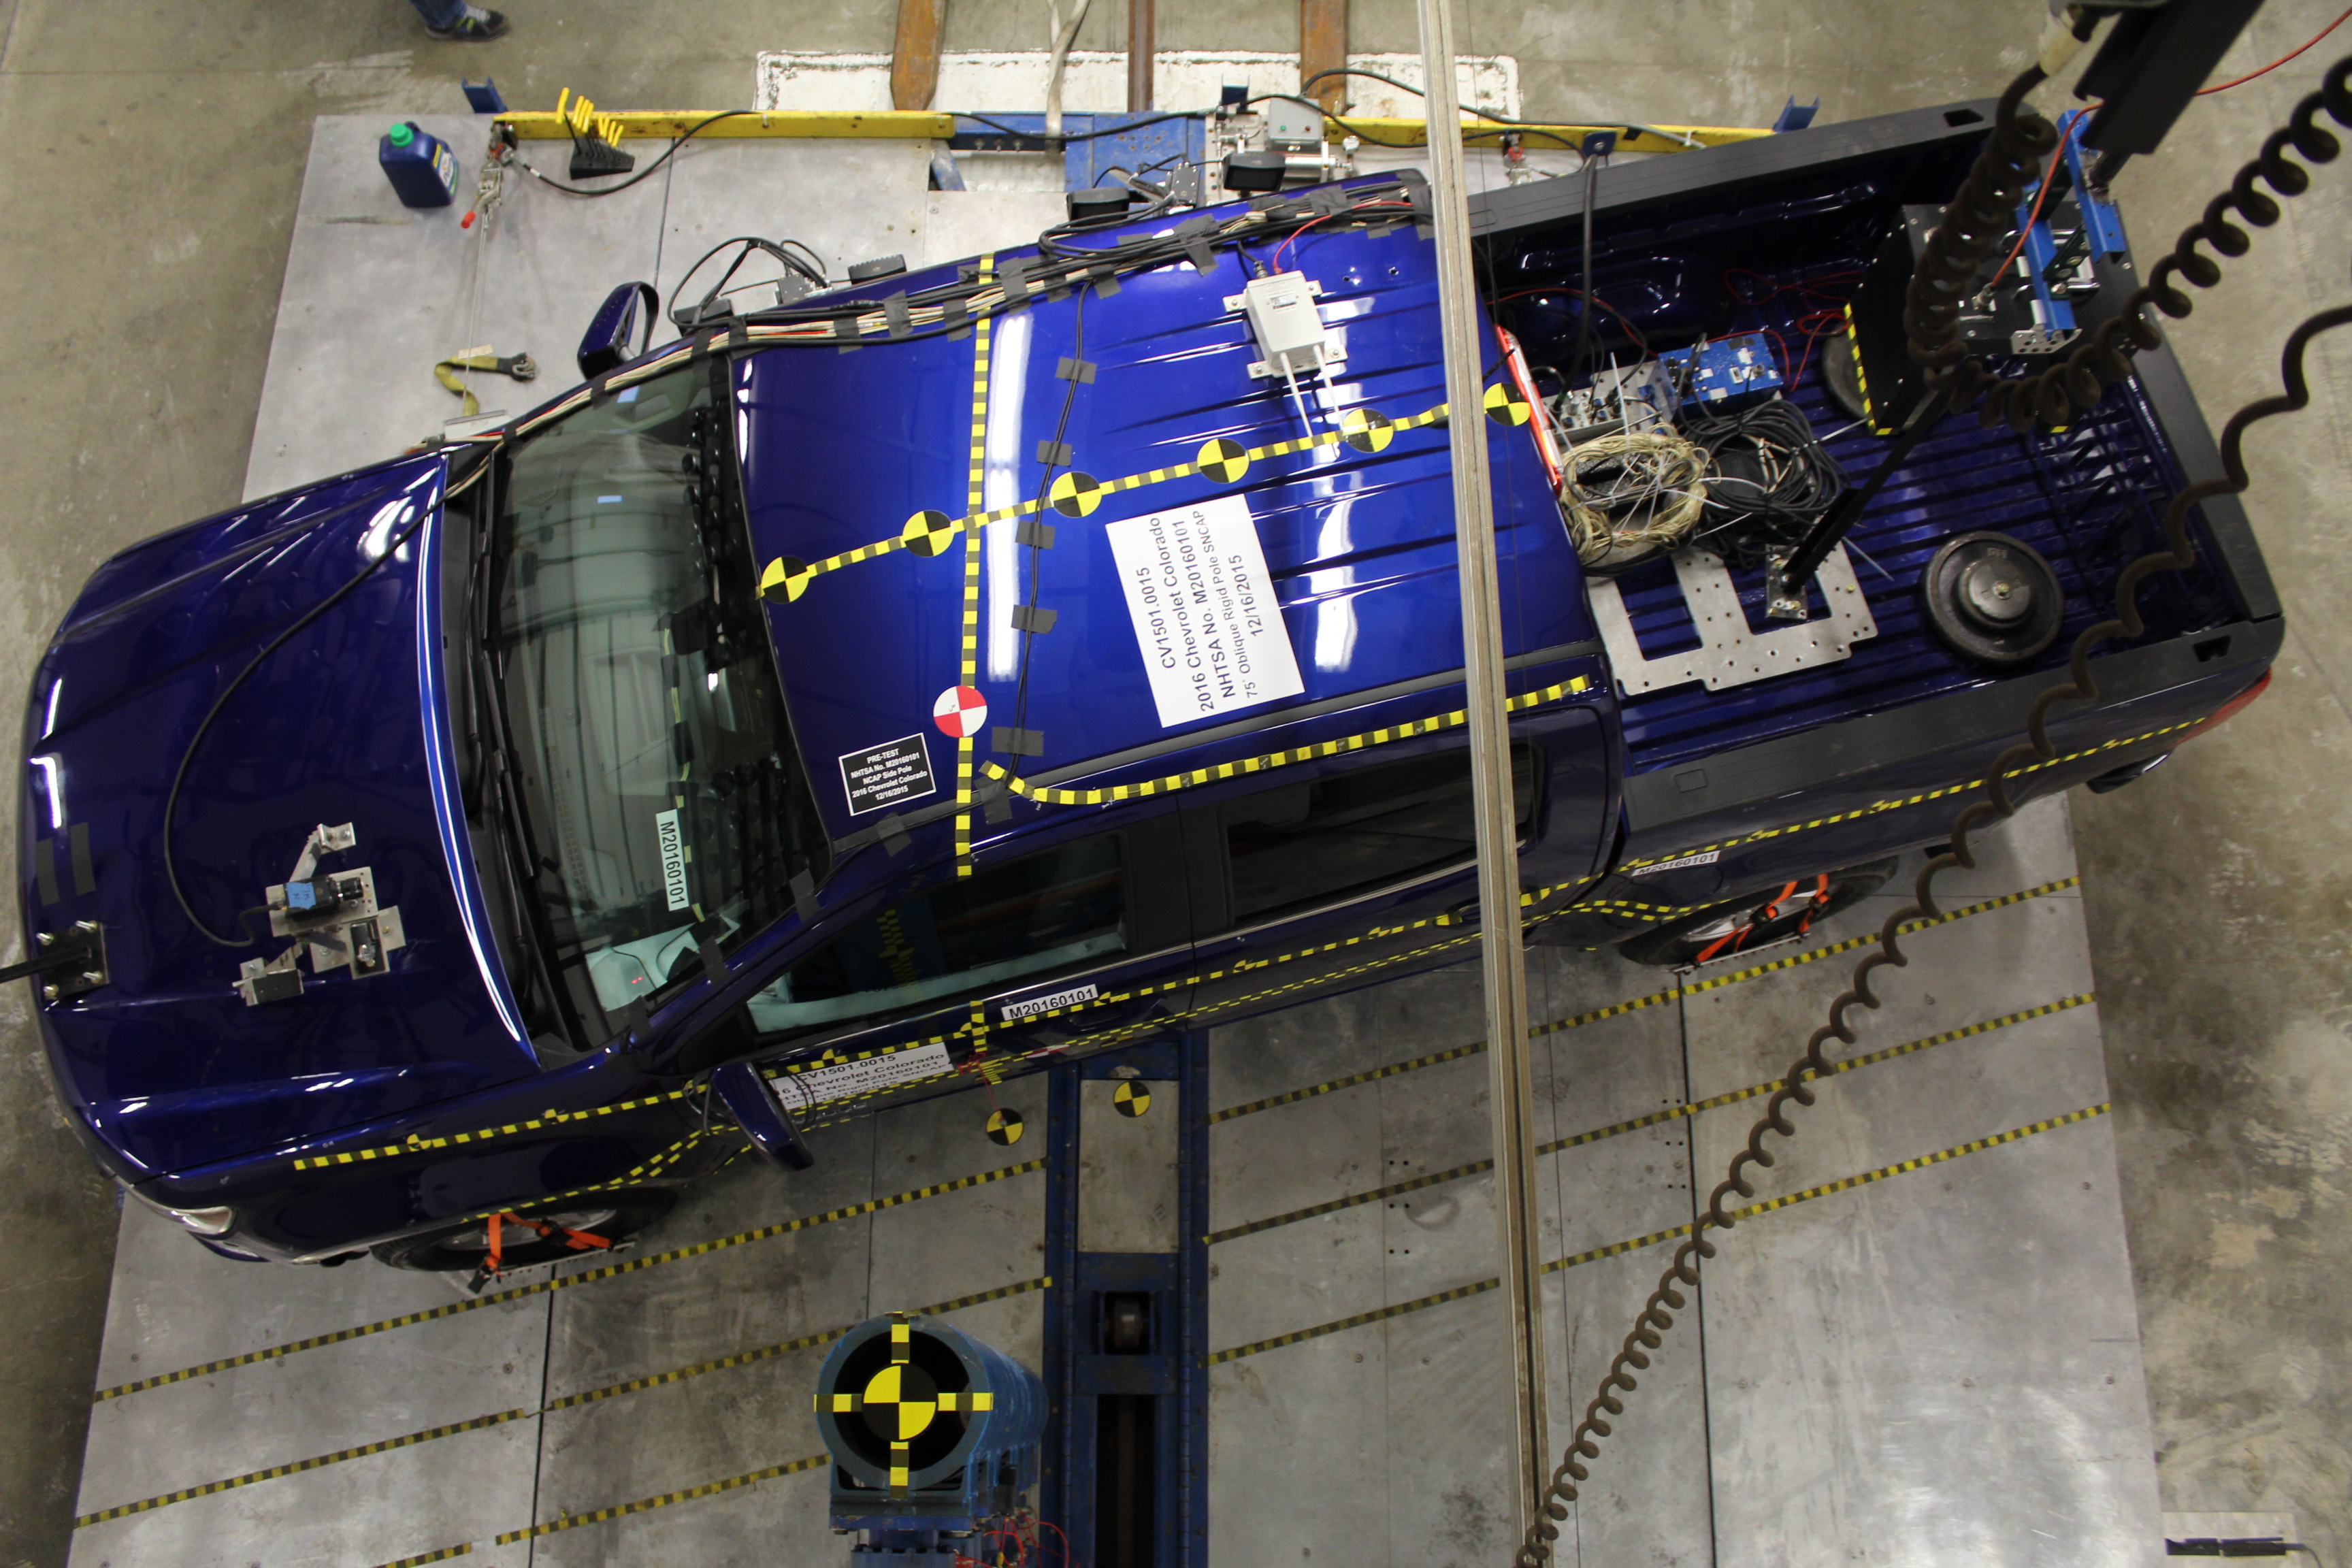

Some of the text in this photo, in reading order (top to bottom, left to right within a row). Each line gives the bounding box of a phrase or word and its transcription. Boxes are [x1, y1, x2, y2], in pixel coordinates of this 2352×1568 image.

[1193, 510, 1213, 553] SNCAP
[1209, 557, 1223, 584] Pole
[1173, 521, 1235, 698] NHTSA No. M20160101
[1216, 588, 1234, 620] Rigid
[1229, 555, 1263, 636] 12/16/2015
[1137, 568, 1175, 668] CV1501.0015
[1149, 519, 1214, 711] 2016 Chevrolet Colorado
[1230, 625, 1250, 673] Oblique
[851, 766, 874, 779] NHTSA
[885, 752, 919, 768] M20160101
[867, 749, 898, 764] PRE-TEST
[852, 770, 928, 798] 2016 Chevrolet Colorado
[863, 766, 912, 785] NCAP Side Pole
[660, 821, 685, 904] M20160101
[1639, 853, 1714, 875] M20160101
[1009, 988, 1094, 1018] M20160101
[874, 1053, 944, 1073] Colorado
